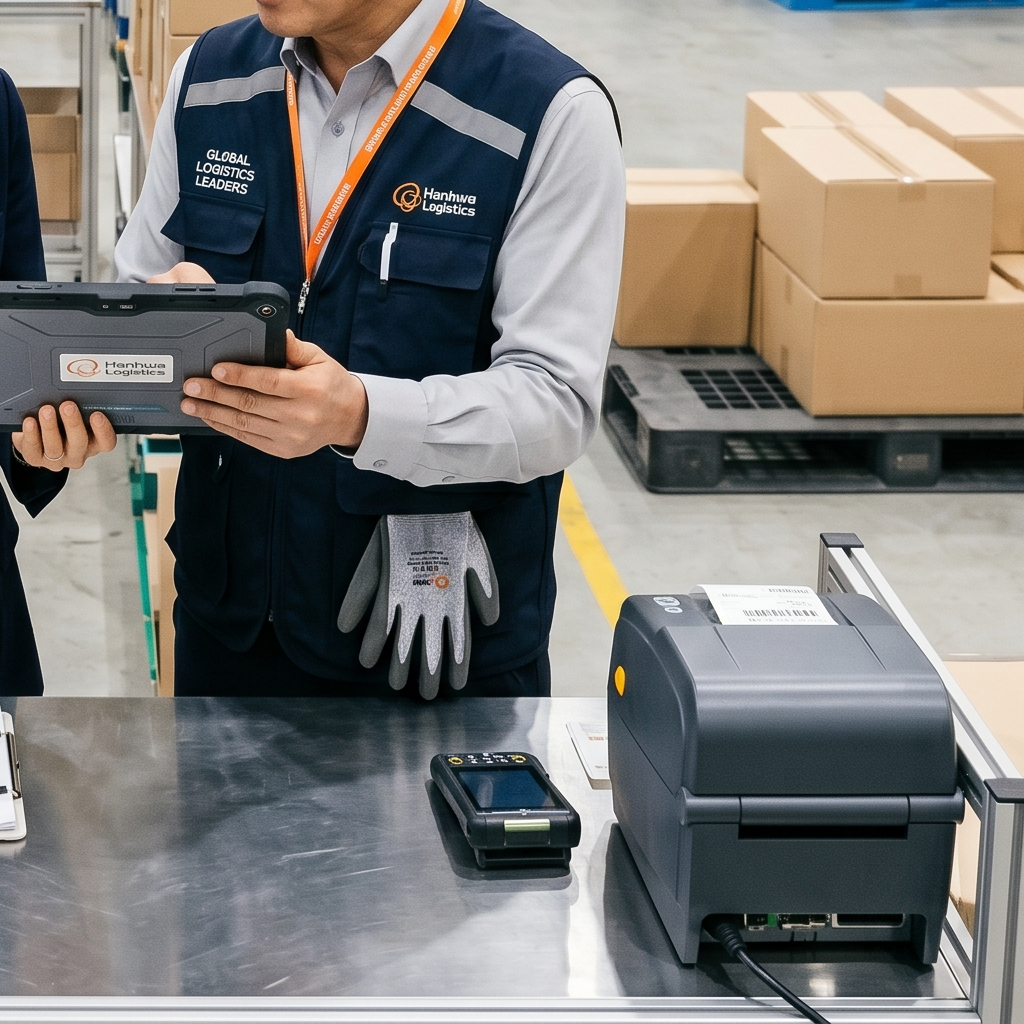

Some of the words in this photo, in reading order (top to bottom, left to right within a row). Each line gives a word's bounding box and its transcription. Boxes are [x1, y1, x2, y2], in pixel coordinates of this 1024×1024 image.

[206, 149, 251, 166] GLOBAL
[196, 161, 255, 181] LOGISTICS
[195, 175, 248, 195] LEADERS
[422, 200, 476, 216] Logistics
[105, 361, 166, 369] Hanhwa
[105, 369, 166, 377] Logistics
